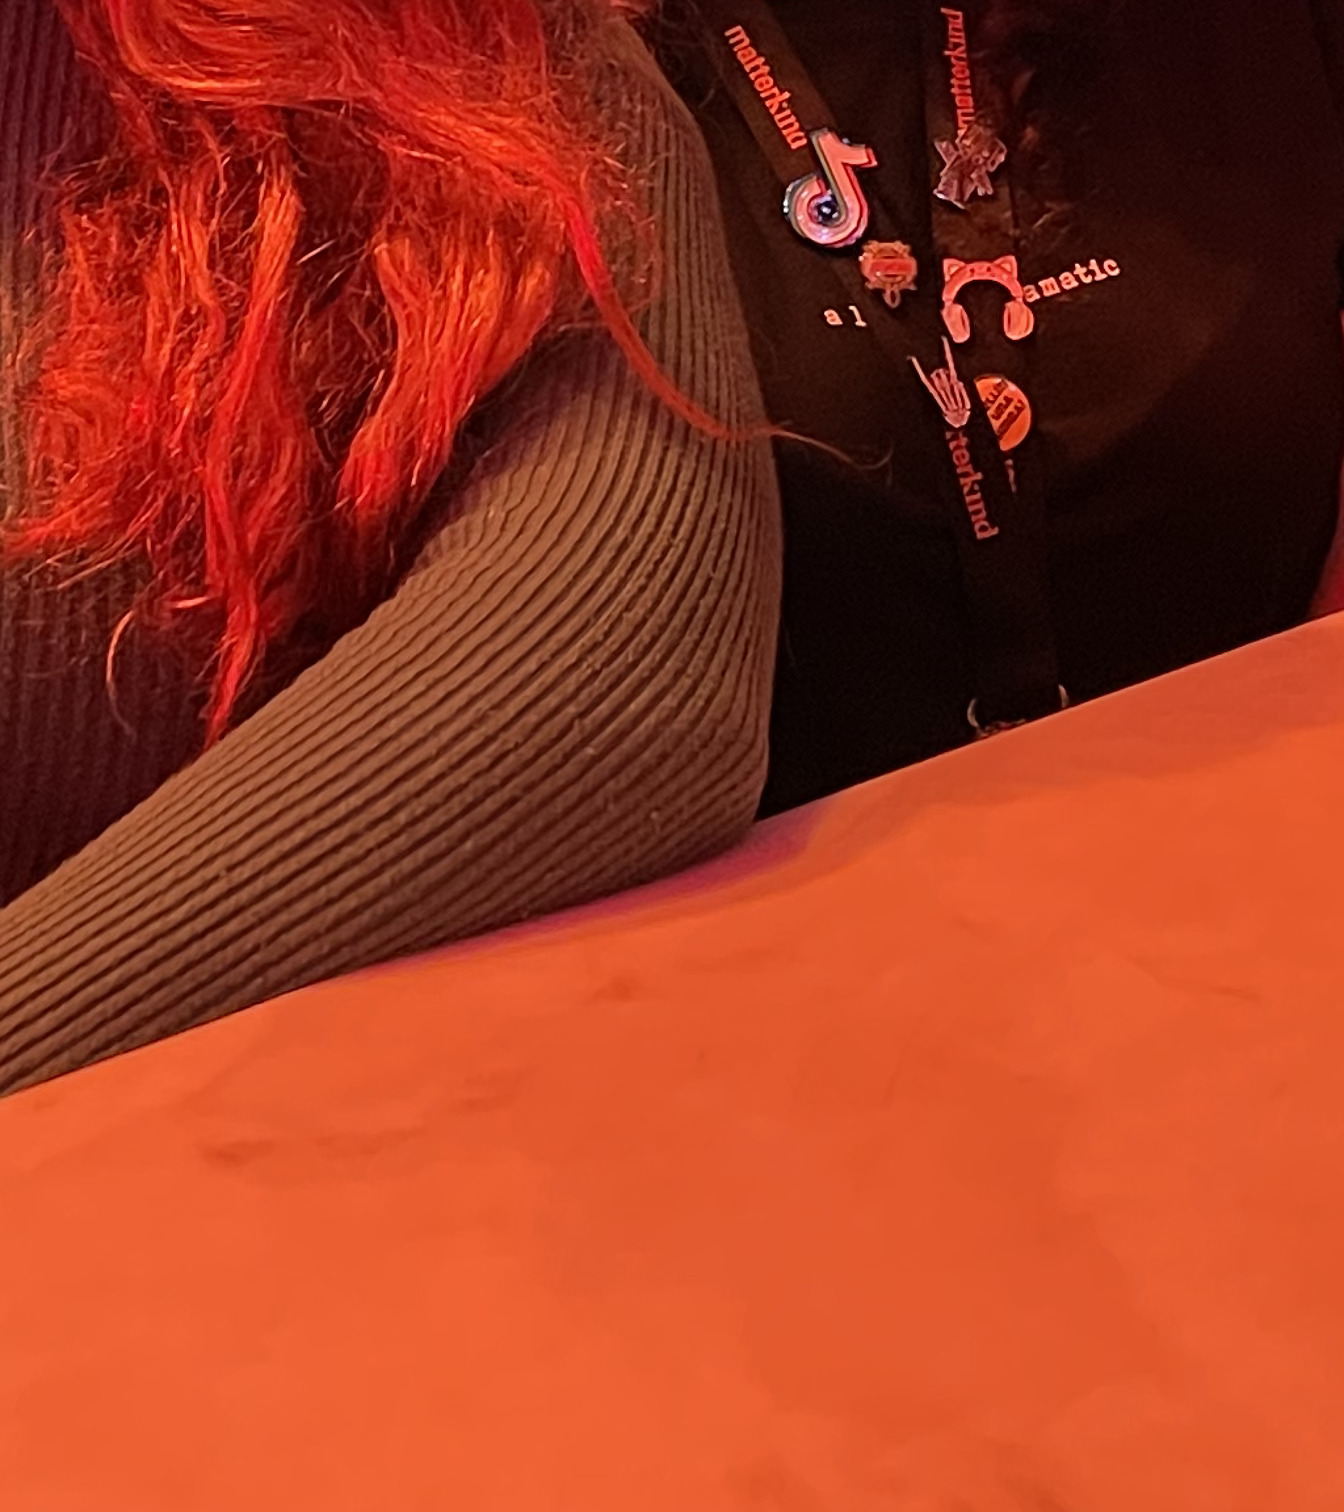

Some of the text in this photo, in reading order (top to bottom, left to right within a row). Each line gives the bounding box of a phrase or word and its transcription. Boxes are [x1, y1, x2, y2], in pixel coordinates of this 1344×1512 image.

[723, 24, 808, 150] matterkind
[1022, 257, 1122, 303] amatic
[945, 429, 1000, 540] tterkind
